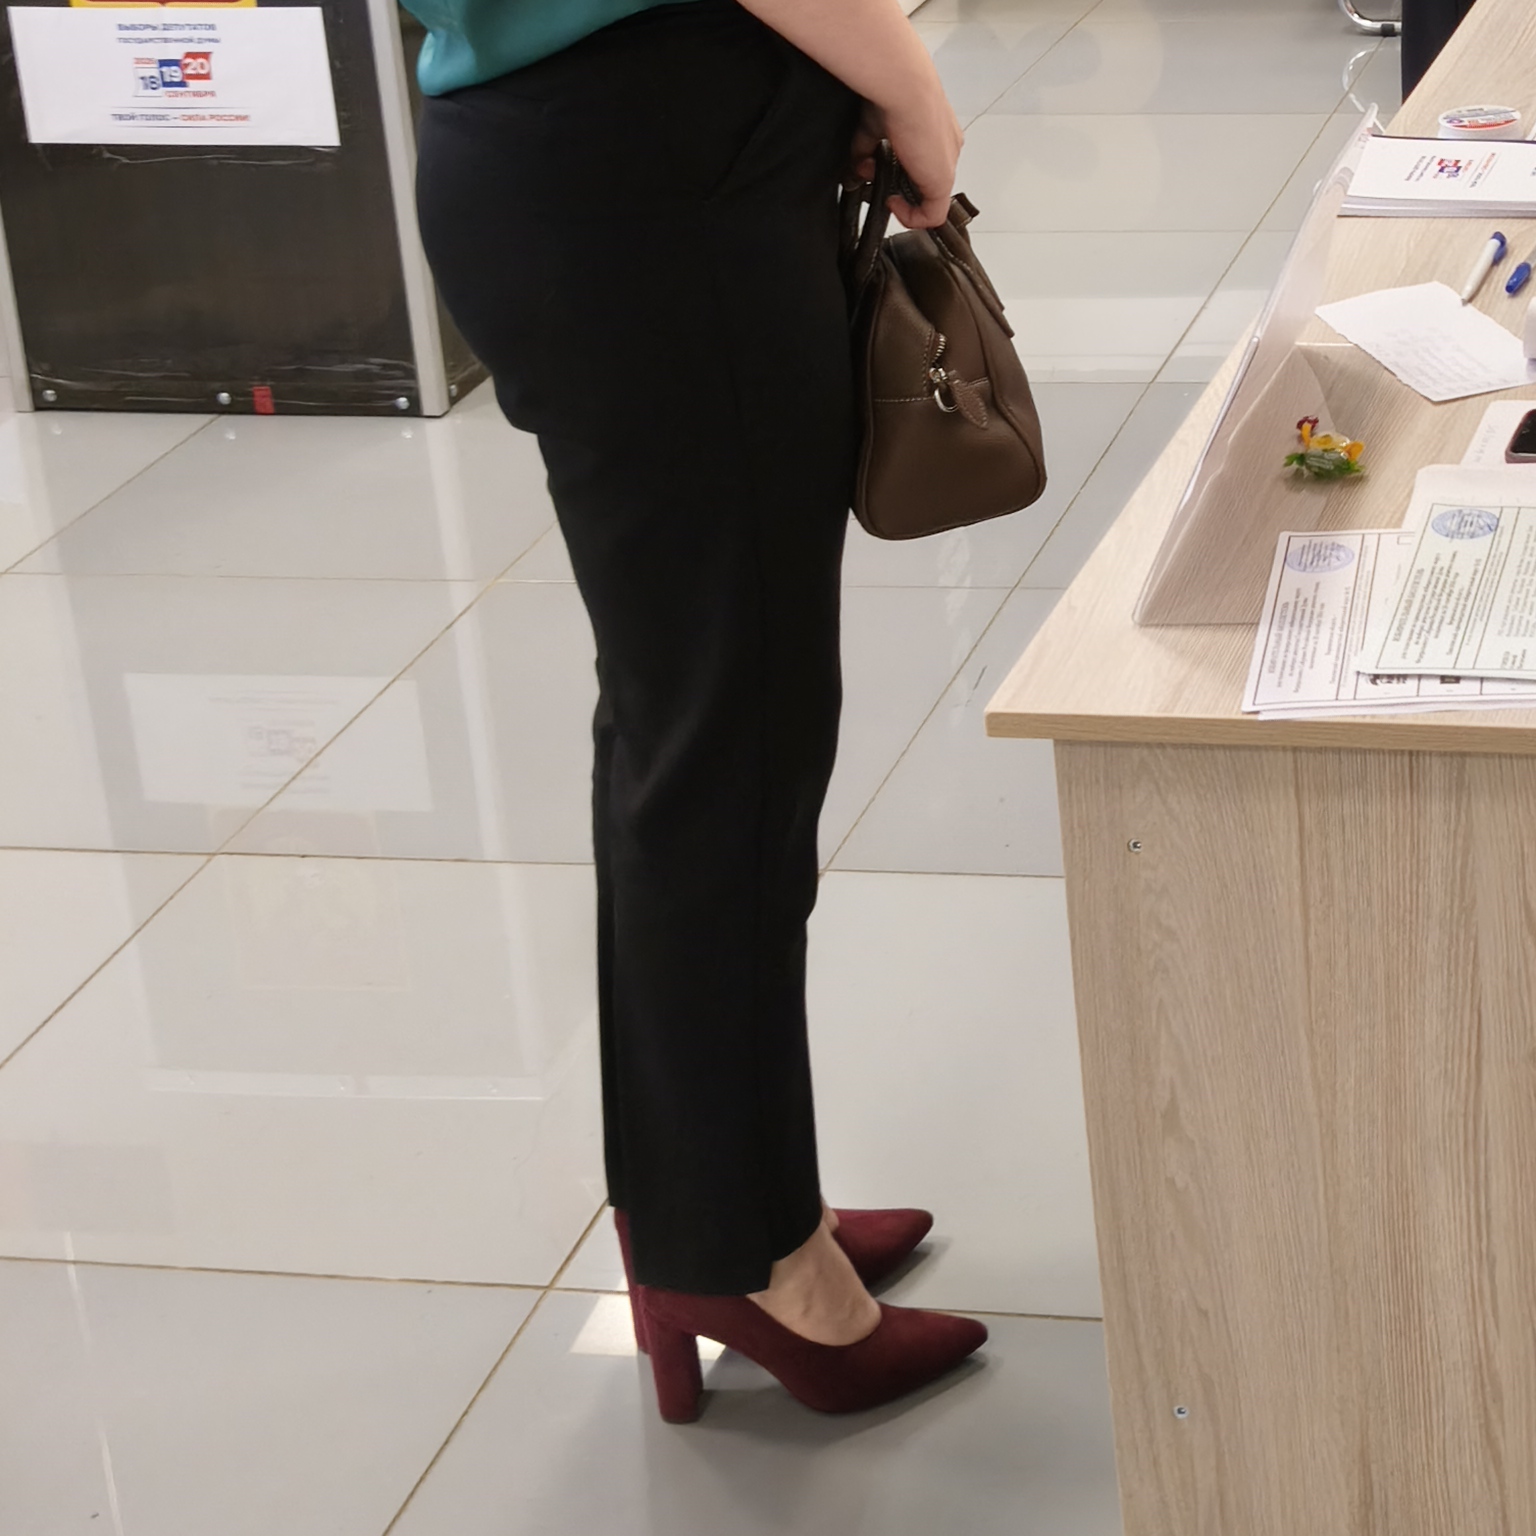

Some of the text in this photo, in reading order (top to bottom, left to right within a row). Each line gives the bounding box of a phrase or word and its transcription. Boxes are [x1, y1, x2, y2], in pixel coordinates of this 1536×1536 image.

[139, 58, 209, 90] 18 19 20
